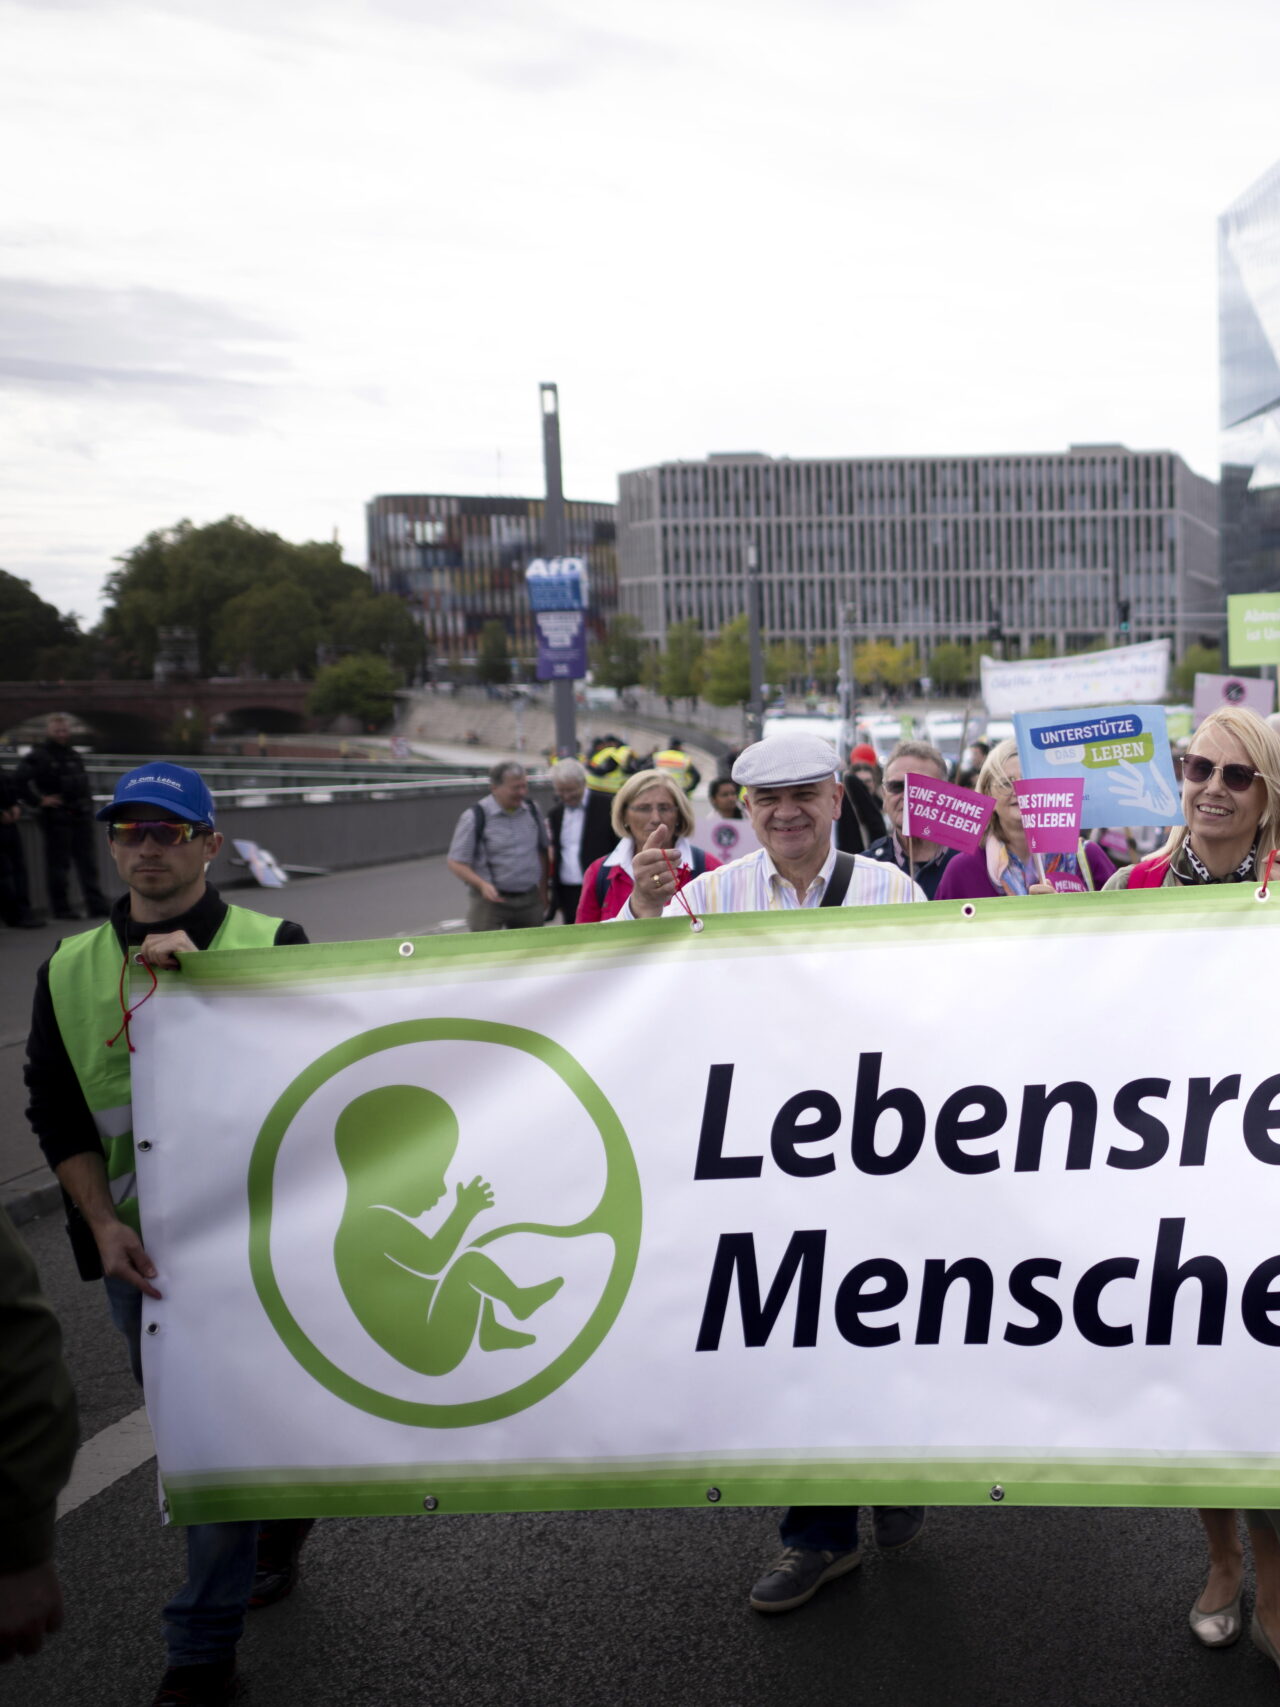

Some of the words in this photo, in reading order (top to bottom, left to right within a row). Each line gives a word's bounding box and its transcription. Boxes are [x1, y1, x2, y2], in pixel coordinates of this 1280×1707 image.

[1040, 720, 1134, 744] UNTERSTÜTZE
[1055, 749, 1077, 760] DAS
[1091, 742, 1145, 762] LEBEN
[909, 785, 936, 803] EINE
[936, 794, 984, 819] STIMME
[1030, 793, 1074, 808] STIMME
[914, 804, 939, 820] DAS
[939, 812, 982, 835] LEBEN
[1038, 813, 1076, 828] LEBEN
